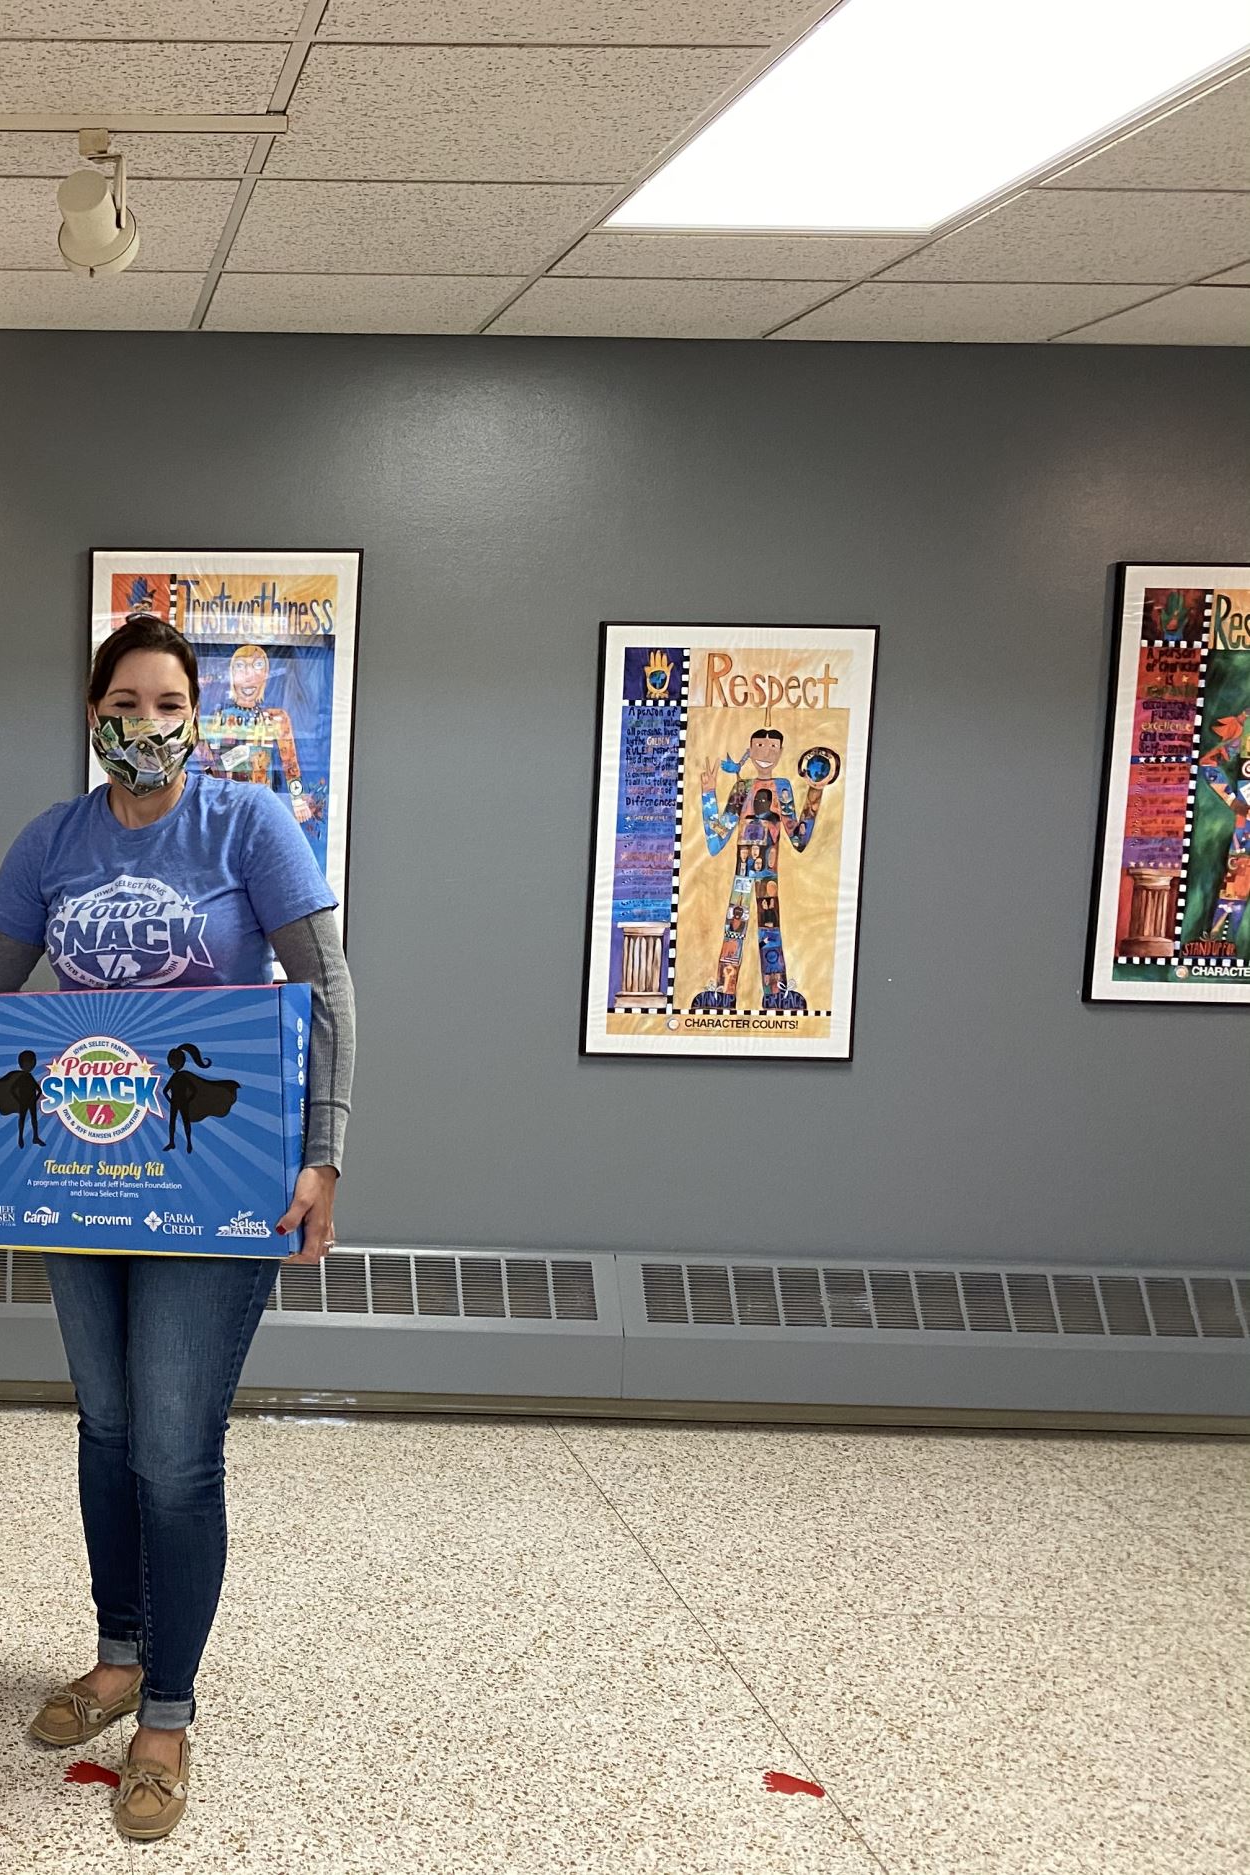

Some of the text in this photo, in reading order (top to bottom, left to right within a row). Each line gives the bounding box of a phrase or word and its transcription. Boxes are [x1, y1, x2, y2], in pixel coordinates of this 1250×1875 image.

[177, 580, 333, 634] Trustworthiness
[1159, 649, 1196, 661] person
[705, 652, 838, 727] Respect
[628, 707, 677, 719] A person of
[627, 728, 635, 736] all
[1142, 721, 1191, 731] excellence
[626, 796, 676, 807] Differences
[94, 880, 167, 898] IOWA SELECT FARMS
[70, 900, 176, 919] Power
[48, 914, 213, 968] SNACK
[685, 1018, 799, 1030] CHARACTER COUNTS!
[73, 1041, 130, 1057] IOWA SELECT FARMS
[61, 1057, 138, 1076] Power
[42, 1076, 162, 1117] SNACK
[75, 1125, 86, 1134] JEFF
[113, 1108, 140, 1138] FOUNDATION
[44, 1160, 164, 1180] Teacher Supply Kit
[33, 1180, 59, 1188] program
[60, 1179, 68, 1187] of
[99, 1190, 119, 1198] Select
[24, 1210, 60, 1226] Cargill
[85, 1215, 132, 1226] provimi
[164, 1211, 194, 1224] FARM
[230, 1218, 266, 1229] Select
[162, 1224, 204, 1235] CREDIT
